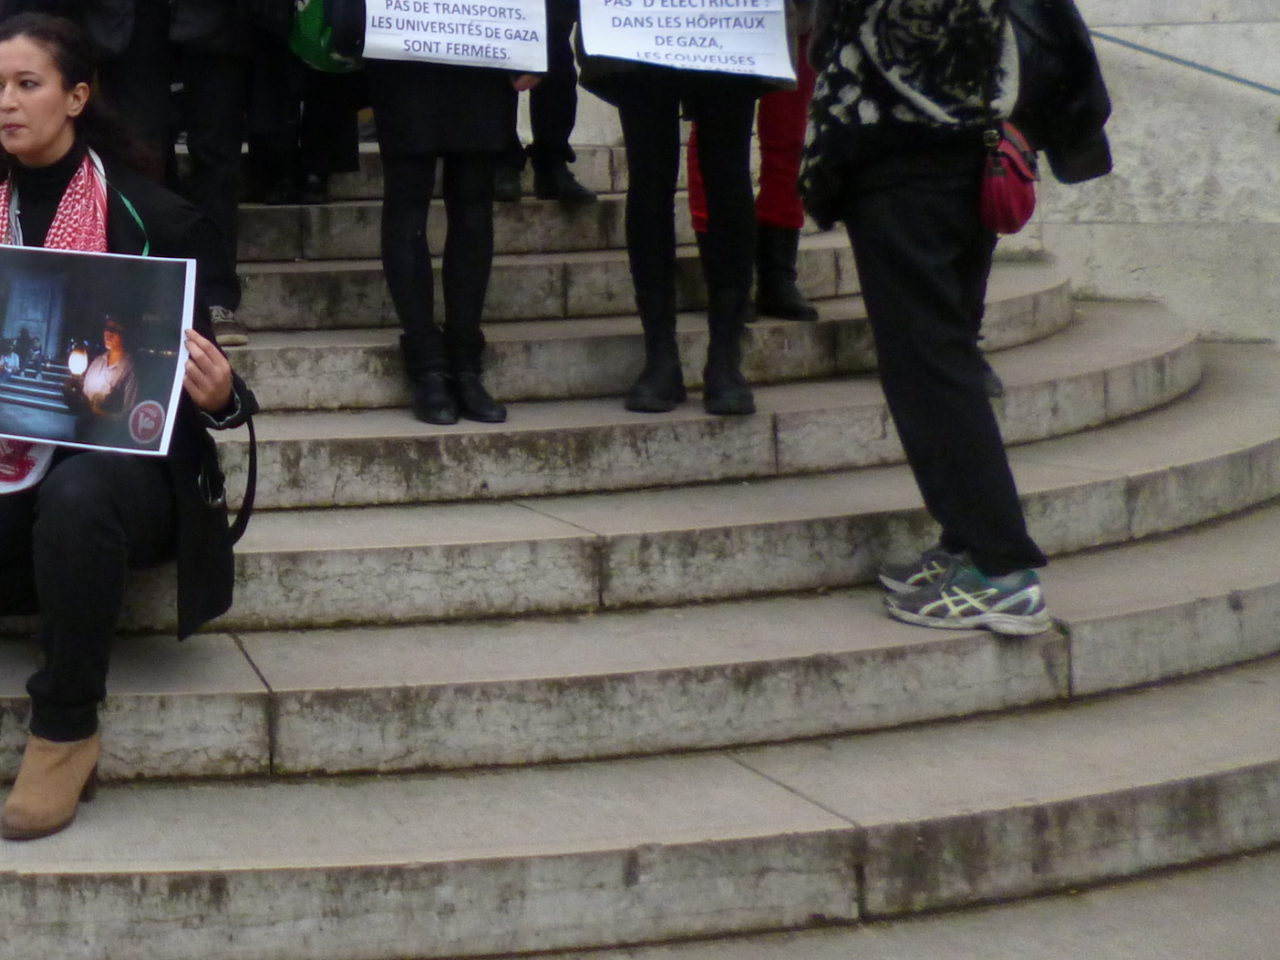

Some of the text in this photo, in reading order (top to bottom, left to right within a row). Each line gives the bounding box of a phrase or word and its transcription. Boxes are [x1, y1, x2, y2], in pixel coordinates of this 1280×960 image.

[413, 1, 430, 14] DE
[433, 3, 526, 21] TRANSPORTS.
[611, 13, 766, 29] DANS LES HÔPITAUX
[371, 16, 540, 43] LES UNIVERSITÉS DE GAZA
[404, 39, 511, 61] SONT FERMÉES.
[655, 36, 724, 50] DE GAZA,
